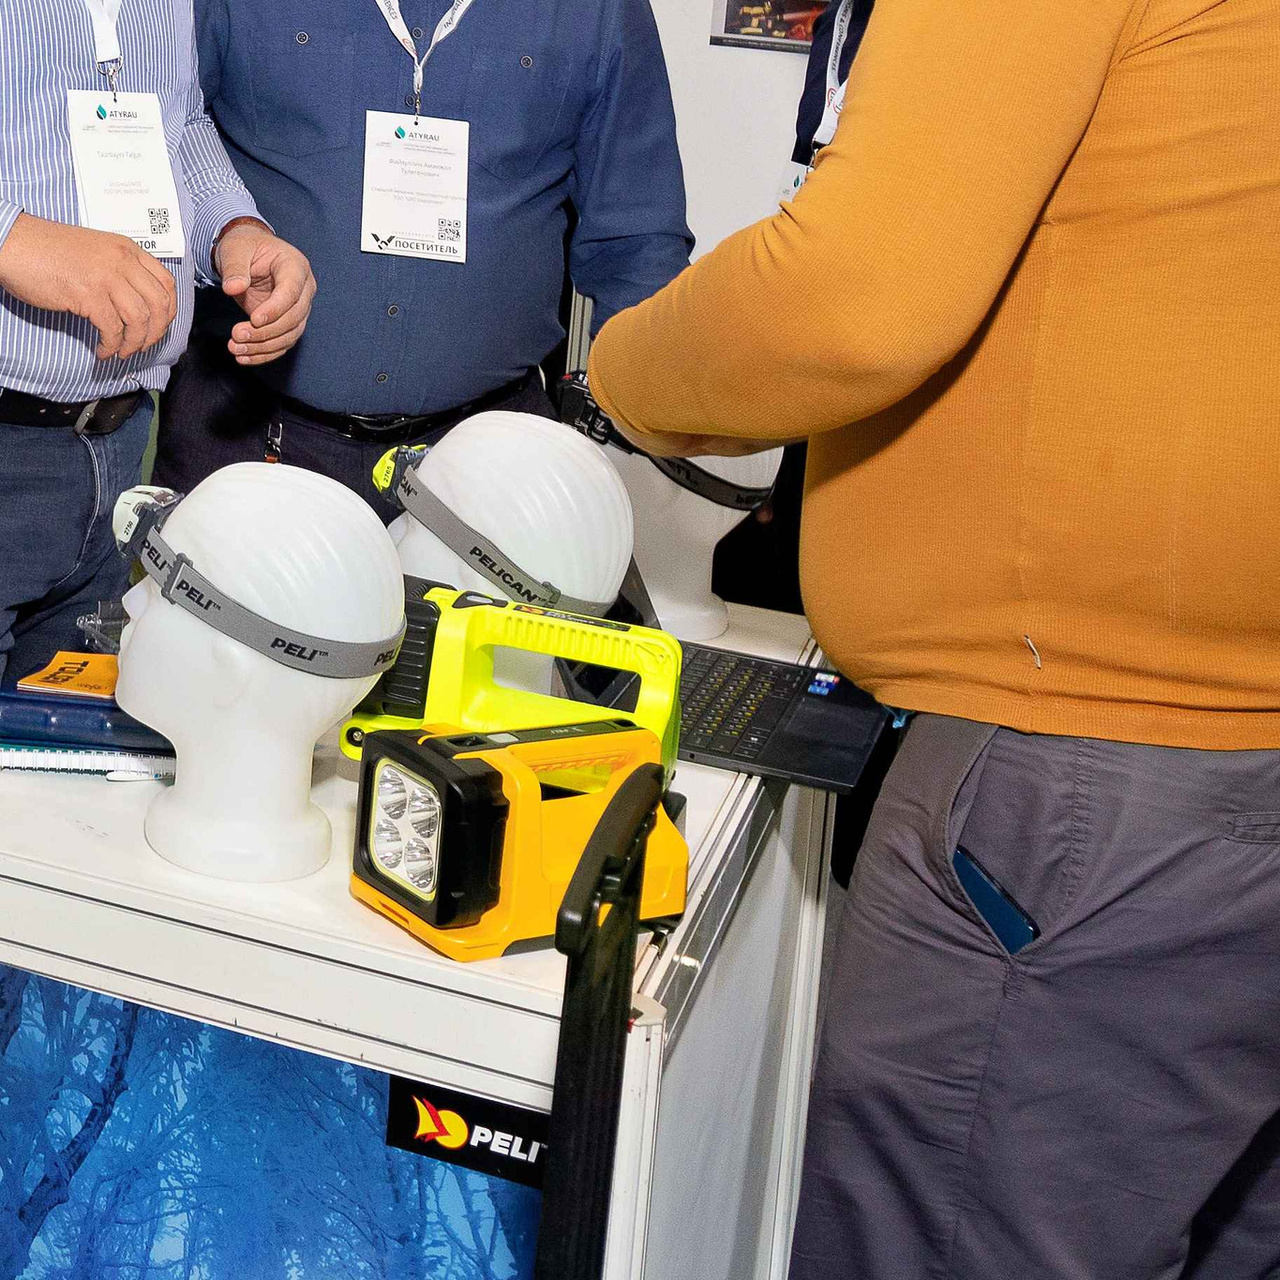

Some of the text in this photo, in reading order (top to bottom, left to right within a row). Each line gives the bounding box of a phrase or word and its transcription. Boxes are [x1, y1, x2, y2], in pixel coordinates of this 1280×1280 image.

[109, 110, 138, 119] ATYRAU
[408, 131, 440, 142] ATYRAU
[395, 240, 458, 254] ПОСЕТИТЕЛЬ
[383, 465, 393, 483] 2765
[123, 520, 134, 536] 2750
